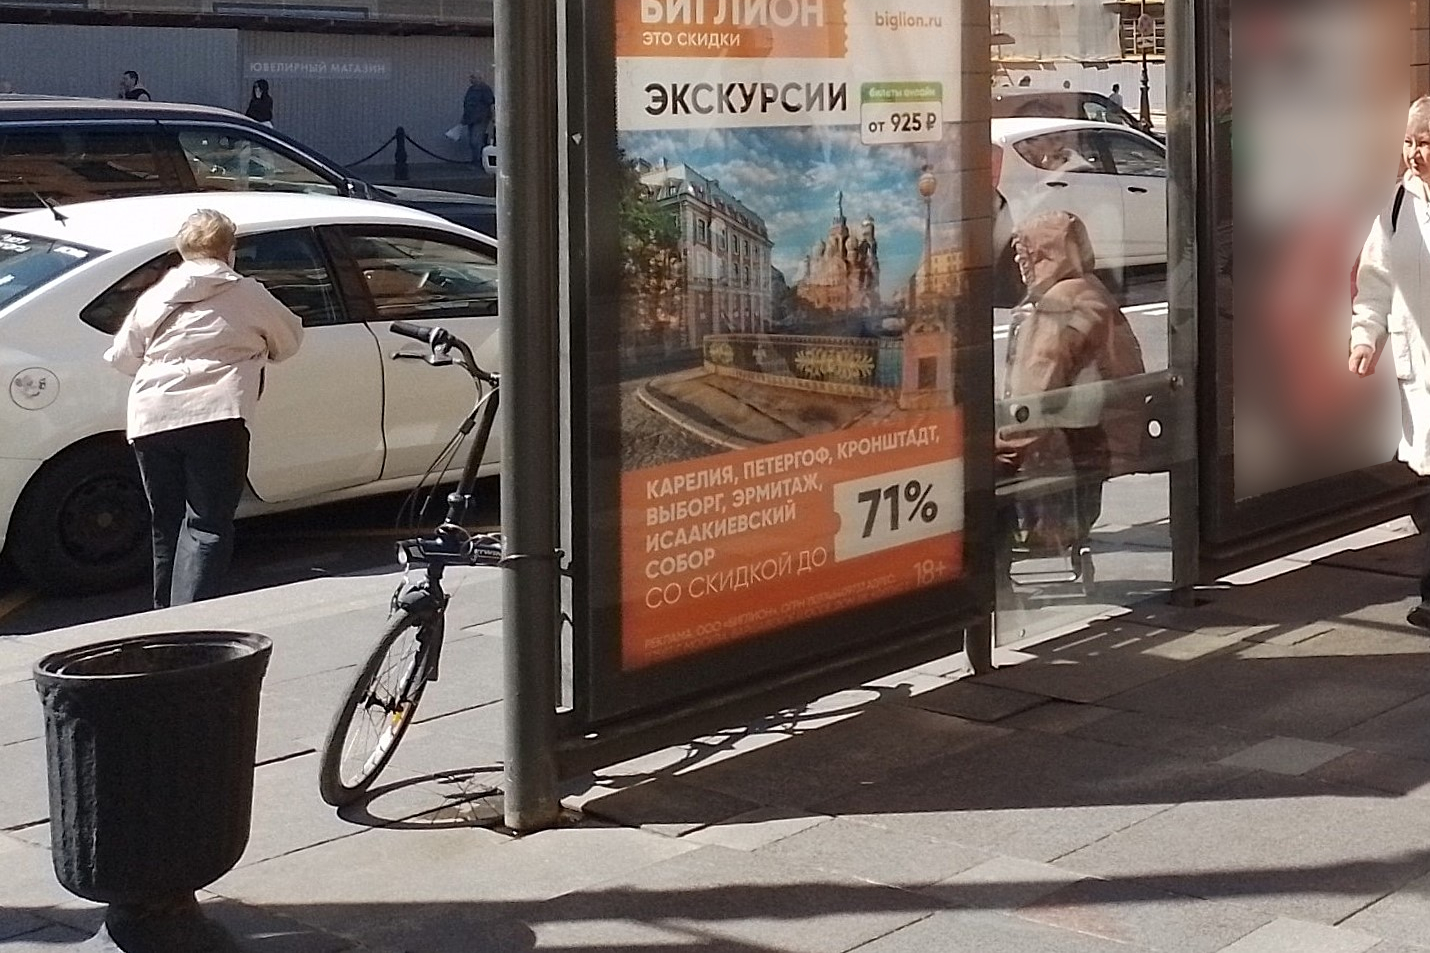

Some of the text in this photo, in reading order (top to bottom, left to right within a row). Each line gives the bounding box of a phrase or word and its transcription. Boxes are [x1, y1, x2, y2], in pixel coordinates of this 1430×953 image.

[875, 11, 943, 31] biglion.ru
[642, 31, 740, 48] ЭТО СКИДКИ
[250, 61, 385, 73] ЮВЕЛИРНЫЙ МАГАЗИН
[644, 82, 847, 116] ЭКСКУРСИИ
[868, 120, 885, 133] от
[890, 113, 922, 132] 925
[646, 425, 940, 499] КАРЕЛИЯ, ПЕТЕРГОФ, КРОНШТАДТ,
[646, 474, 824, 526] ВЫБОРГ, ЭРМИТАЖ,
[858, 479, 939, 539] 71%
[646, 500, 797, 553] ИСААКИЕВСКИЙ
[645, 548, 716, 579] СОБОР
[646, 578, 682, 609] СО
[689, 550, 792, 599] СКИДКОЙ
[797, 546, 827, 576] ДО
[913, 559, 947, 588] 18+
